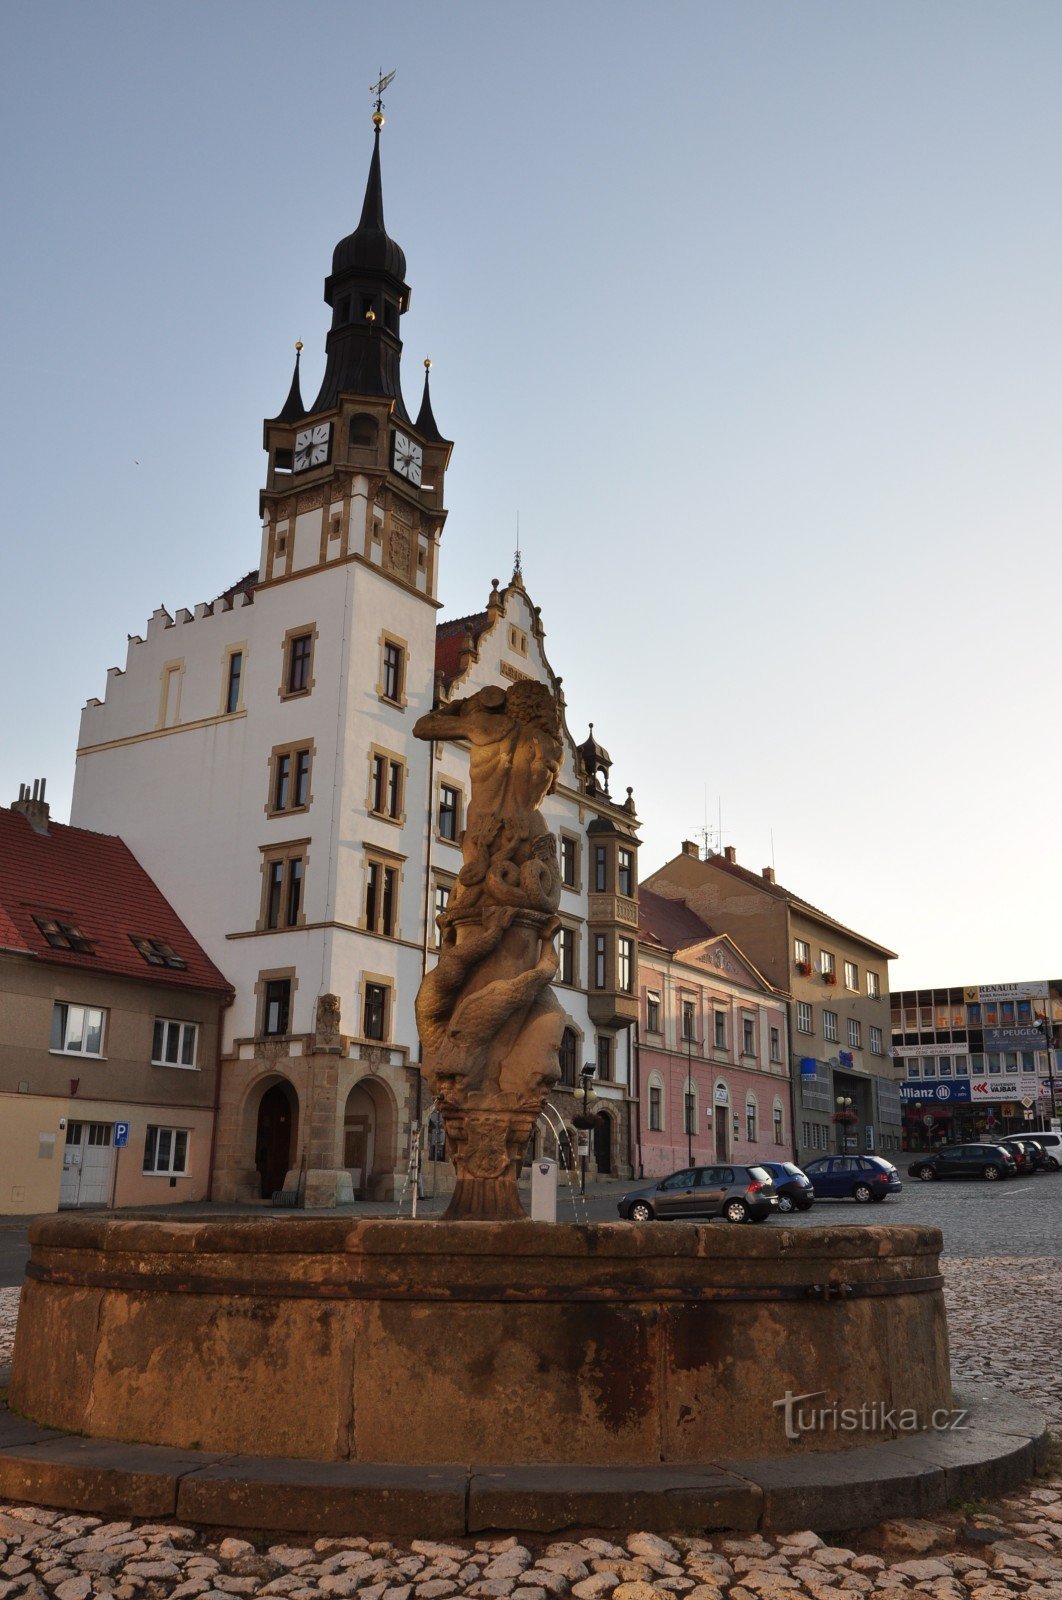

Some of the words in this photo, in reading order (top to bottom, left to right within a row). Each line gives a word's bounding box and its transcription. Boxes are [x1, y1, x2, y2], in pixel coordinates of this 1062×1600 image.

[979, 984, 1018, 993] RENAULT
[1003, 1028, 1042, 1037] PEUGEO
[900, 1087, 934, 1098] Allianz
[117, 1125, 126, 1139] P
